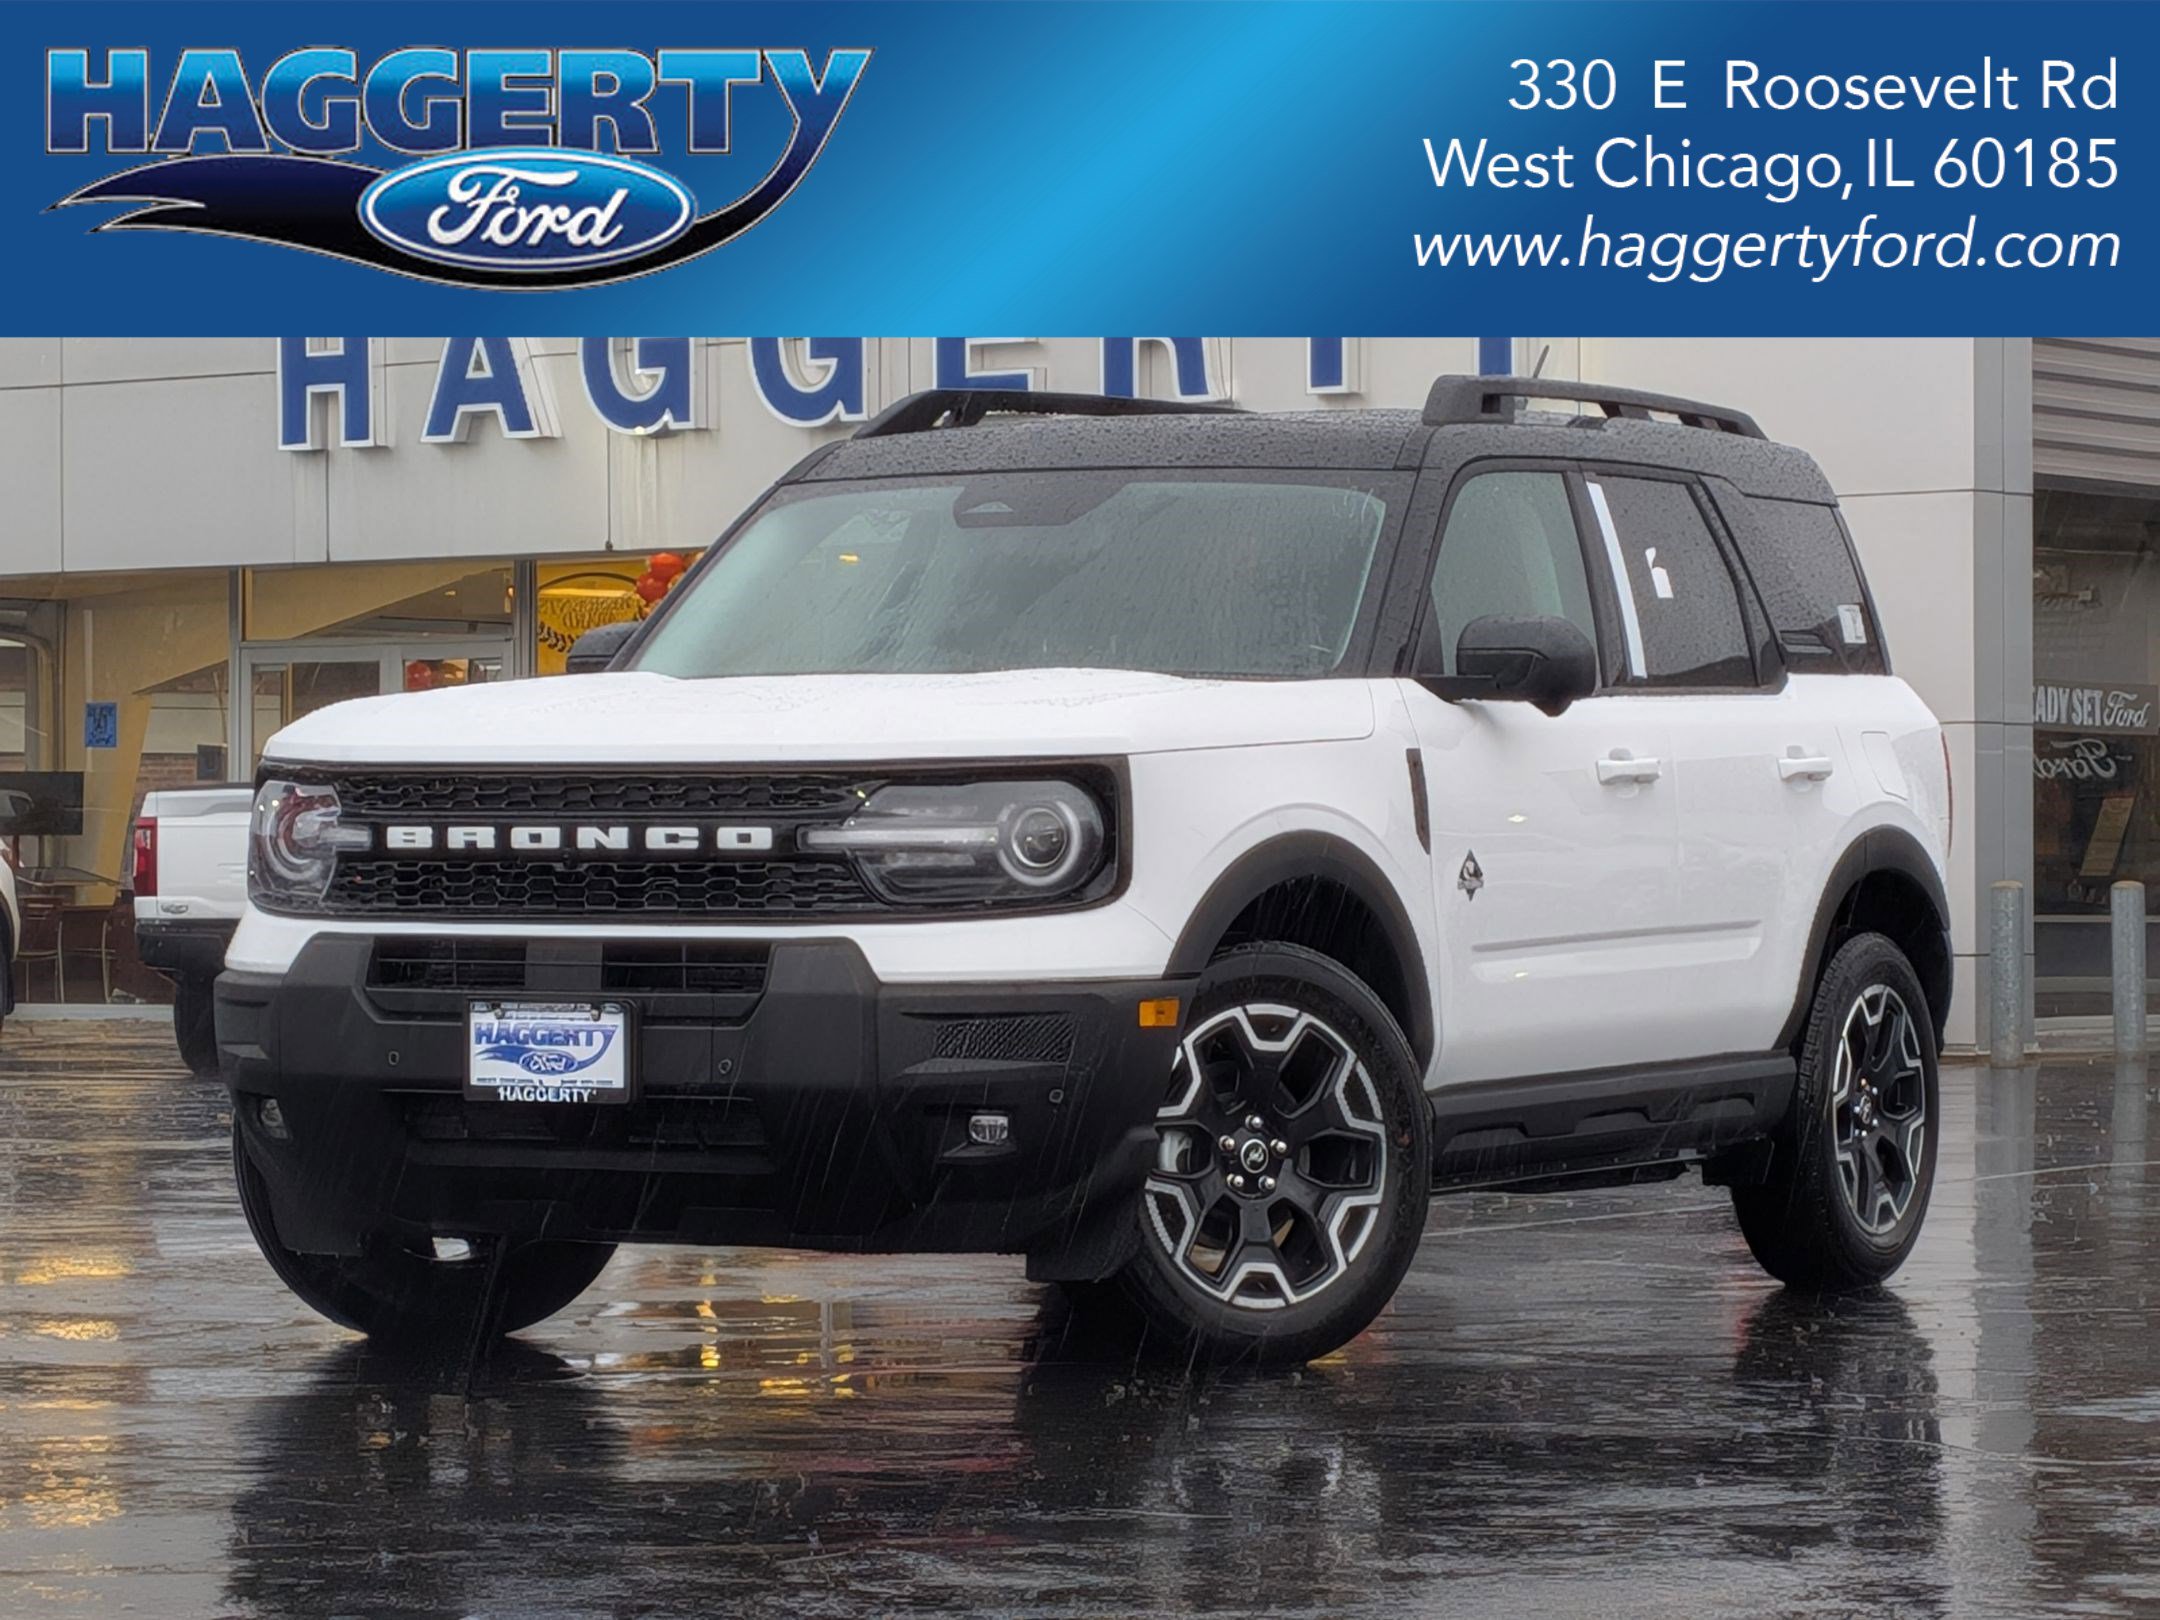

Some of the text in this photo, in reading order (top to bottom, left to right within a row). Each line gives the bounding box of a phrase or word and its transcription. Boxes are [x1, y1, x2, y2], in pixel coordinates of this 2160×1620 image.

[2033, 685, 2151, 728] ADY SET Ford
[386, 826, 773, 850] BRONCO
